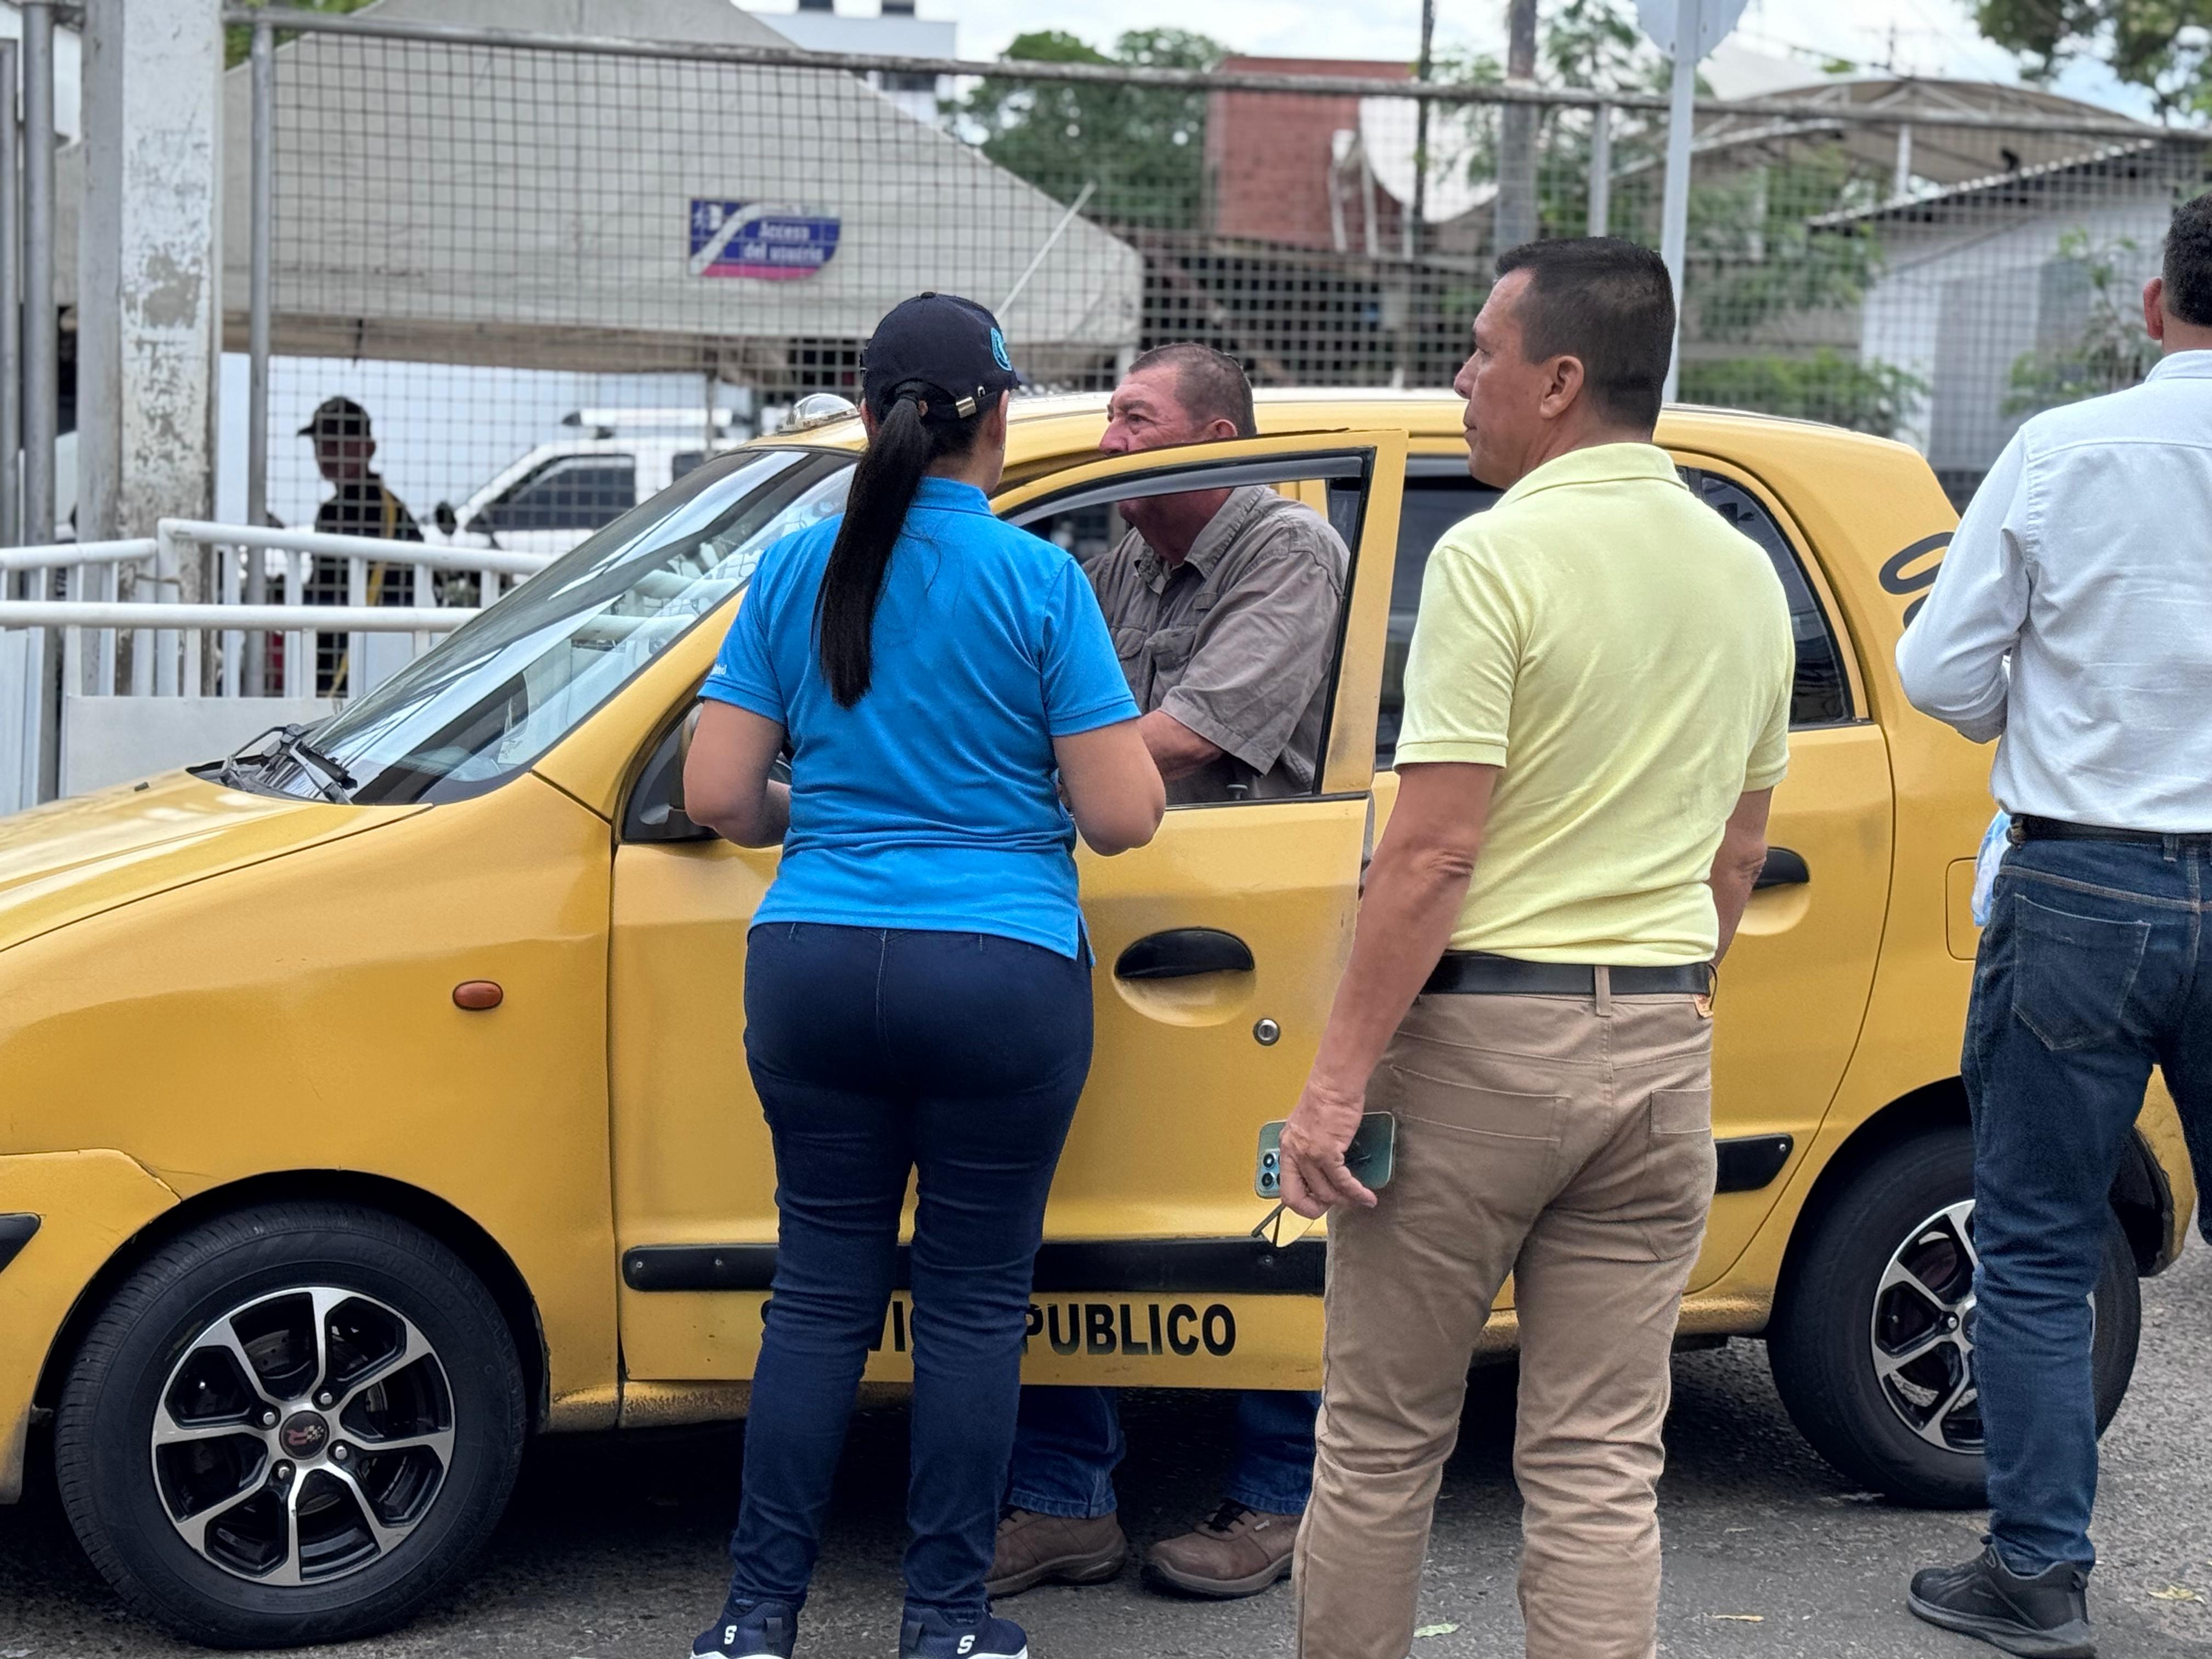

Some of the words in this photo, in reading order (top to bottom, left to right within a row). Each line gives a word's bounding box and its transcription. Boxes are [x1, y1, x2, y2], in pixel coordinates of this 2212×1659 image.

[1023, 1304, 1236, 1356] PUBLICO
[725, 1625, 737, 1645] S
[957, 1635, 975, 1654] S
